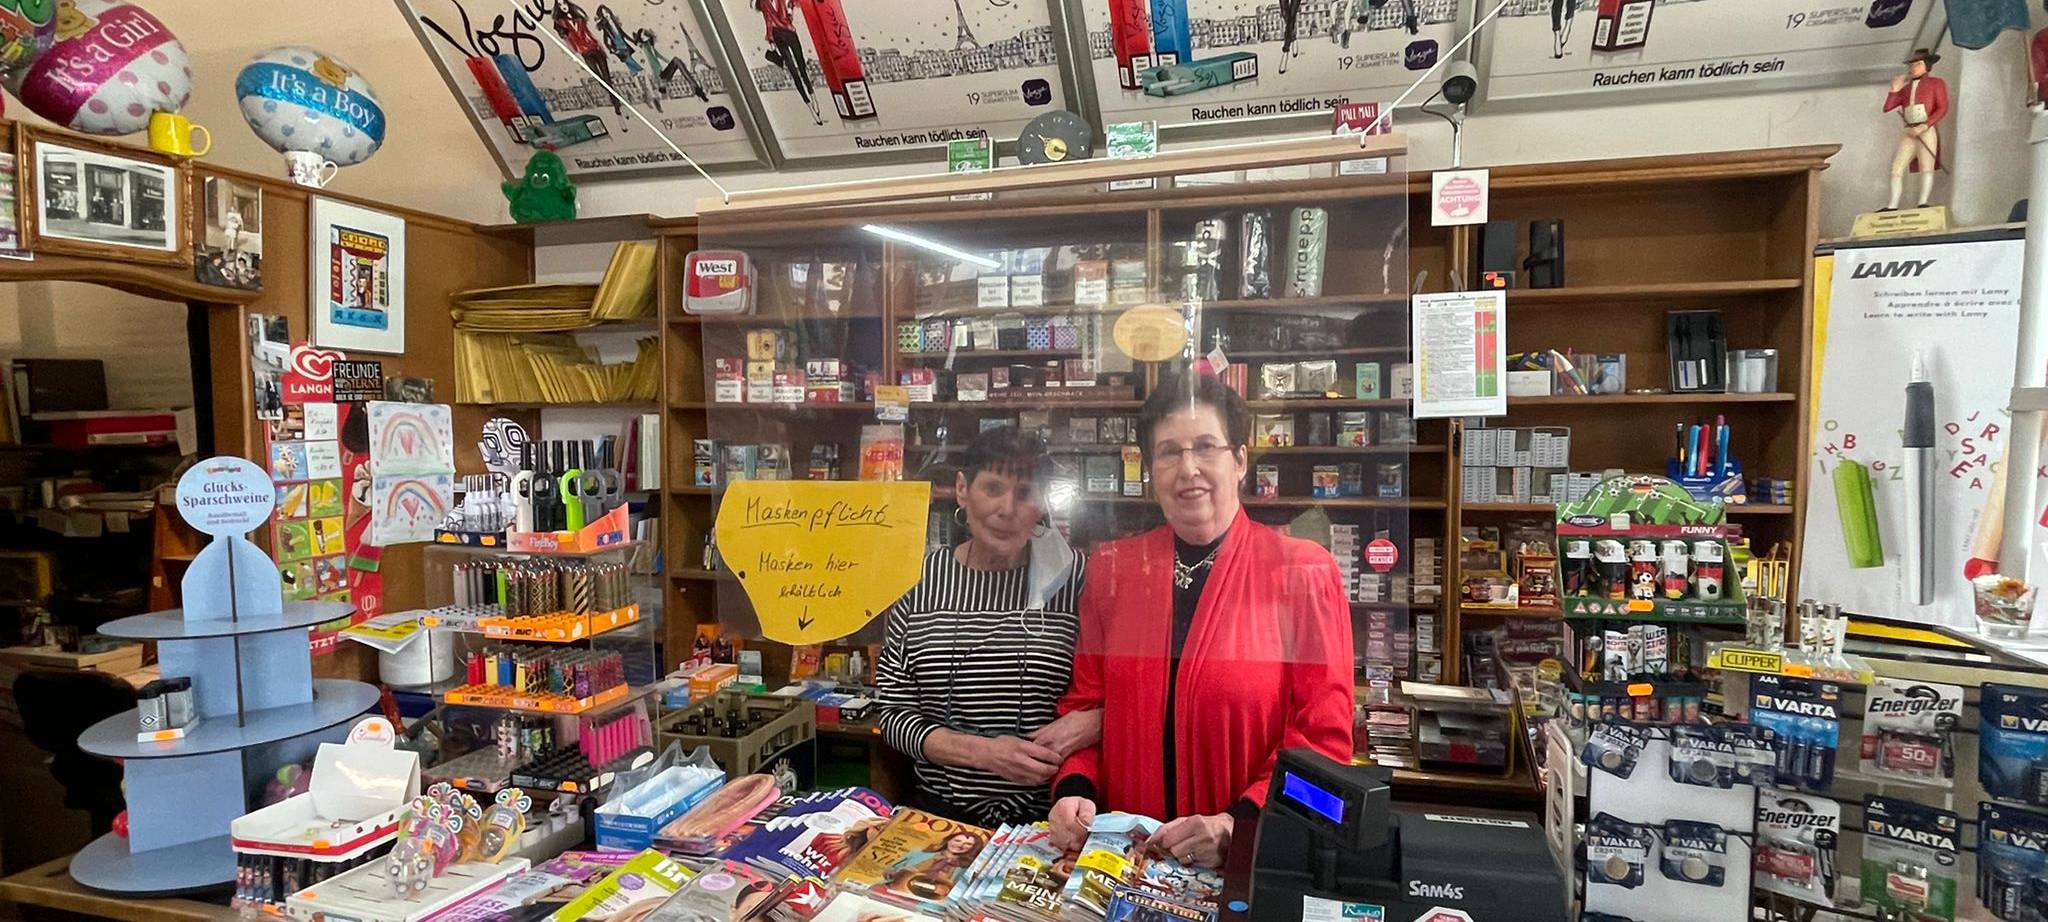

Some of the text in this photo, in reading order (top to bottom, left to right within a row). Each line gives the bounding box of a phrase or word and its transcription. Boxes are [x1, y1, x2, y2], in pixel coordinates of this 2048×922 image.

[1786, 12, 1806, 29] 19
[45, 11, 160, 94] It's a Girl
[1338, 56, 1353, 70] 19
[1593, 60, 1784, 87] Rauchen kann tödlich sein
[272, 70, 376, 128] It's a Boy
[966, 92, 980, 105] 19
[1191, 95, 1350, 121] Rauchen kann tödlich sein
[1341, 107, 1357, 121] PALL
[855, 126, 988, 149] Rauchen kann tödlich sein
[1439, 195, 1480, 205] ACHTUNG
[699, 262, 732, 273] West
[1851, 259, 1938, 280] LAMY
[1874, 289, 1922, 299] Schreiben
[1981, 289, 2009, 298] Lamy
[1961, 309, 1988, 320] Lamy
[333, 362, 381, 380] FREUNDE
[291, 383, 333, 395] LANGN
[1944, 421, 1960, 435] D
[1980, 422, 2000, 442] R
[1843, 433, 1857, 449] B
[1961, 438, 1976, 455] S
[1950, 460, 1974, 479] E
[1968, 477, 1983, 490] A
[182, 493, 269, 509] Sparschweine
[745, 496, 890, 532] Maskenpflicht
[1681, 525, 1718, 534] FUNNY
[759, 551, 860, 573] Masken hier
[1725, 653, 1777, 669] CLIPPER
[1773, 697, 1837, 719] VARTA
[1868, 697, 1959, 715] Energizer
[1757, 806, 1837, 829] Energizer
[1887, 824, 1956, 851] VARTA
[799, 845, 834, 868] Wir
[1408, 880, 1465, 900] SAM4S
[1028, 894, 1062, 911] IST
